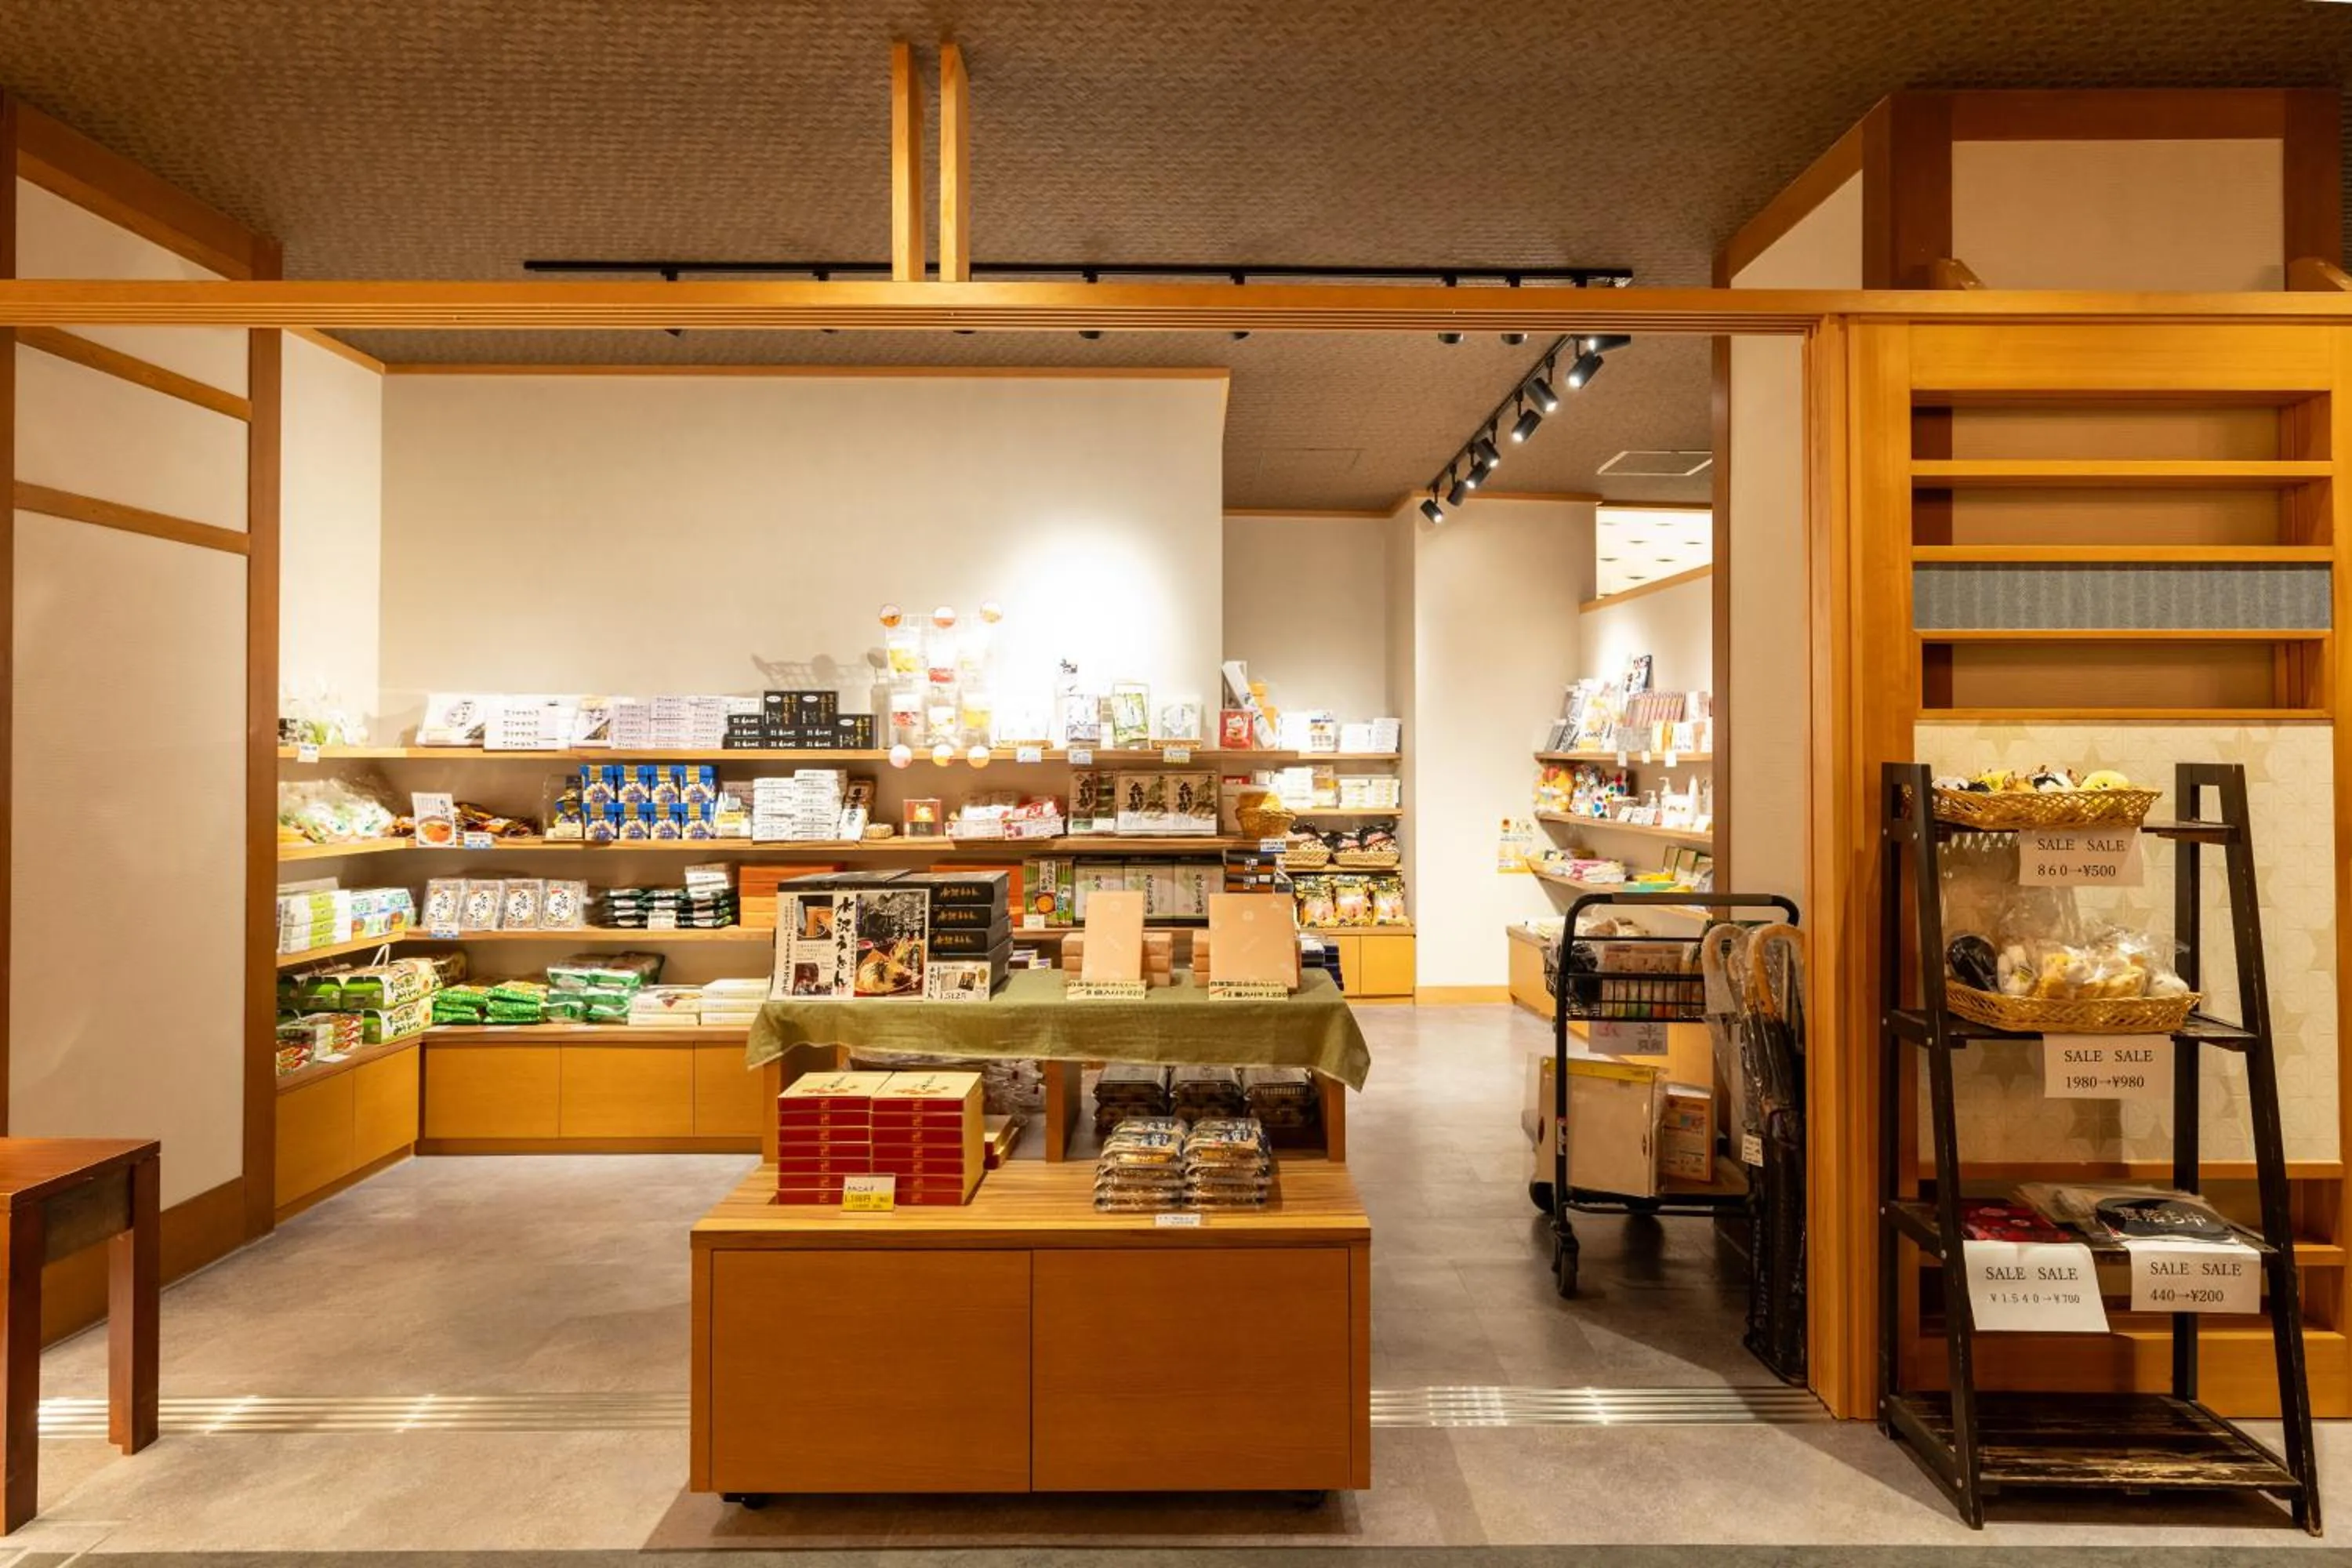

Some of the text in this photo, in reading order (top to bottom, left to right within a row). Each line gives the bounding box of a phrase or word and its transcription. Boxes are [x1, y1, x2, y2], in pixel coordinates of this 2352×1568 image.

[2038, 838, 2125, 851] SALE SALE
[2064, 1050, 2154, 1062] SALE SALE
[1986, 1267, 2078, 1280] SALE SALE
[2151, 1261, 2241, 1276] SALE SALE
